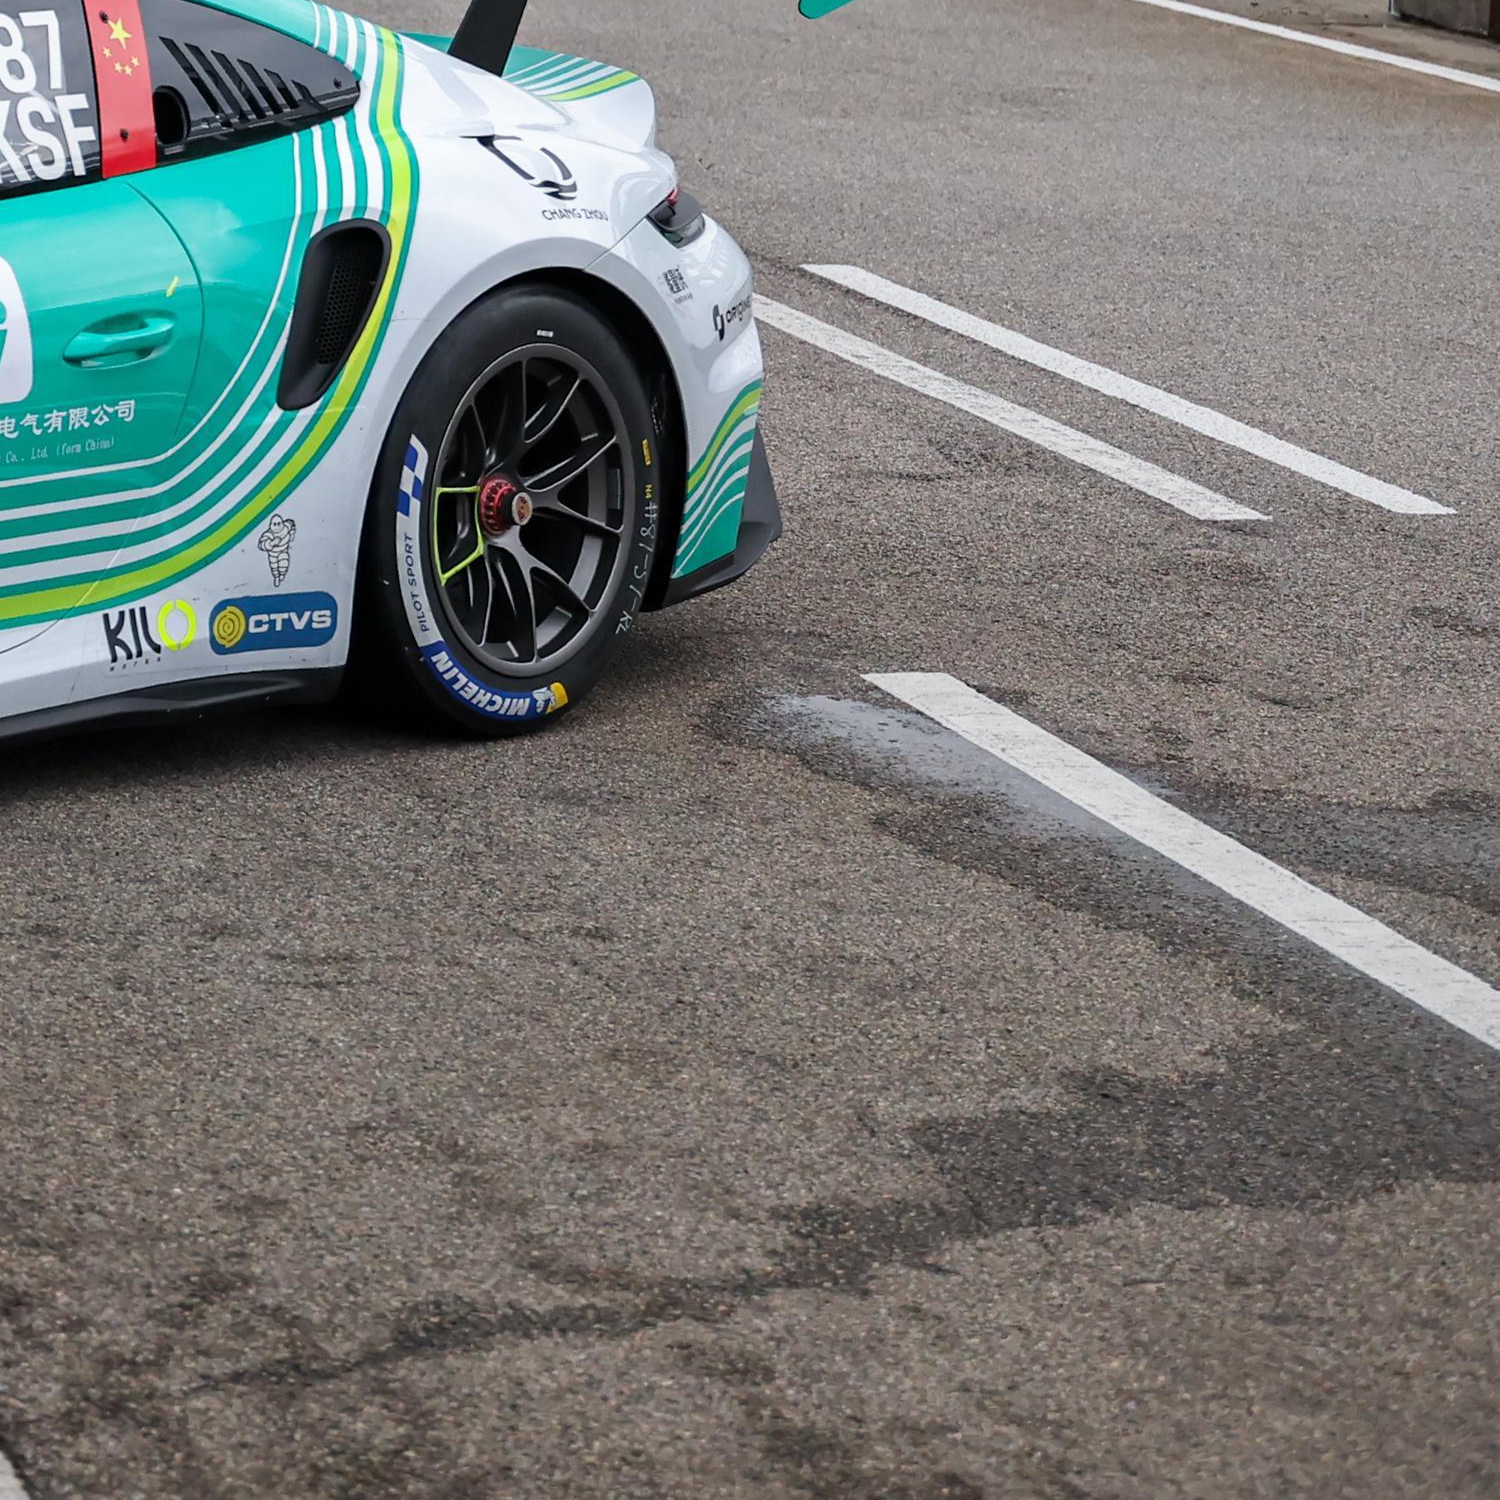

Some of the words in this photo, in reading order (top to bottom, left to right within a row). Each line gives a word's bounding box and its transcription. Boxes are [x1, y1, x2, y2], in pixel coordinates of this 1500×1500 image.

[541, 207, 582, 221] CHANG
[583, 208, 610, 222] ZHOU
[404, 531, 418, 589] SPORT
[102, 599, 198, 664] KILO
[247, 609, 332, 634] CTVS
[409, 591, 430, 634] PILOT
[430, 650, 532, 718] MICHELIN
